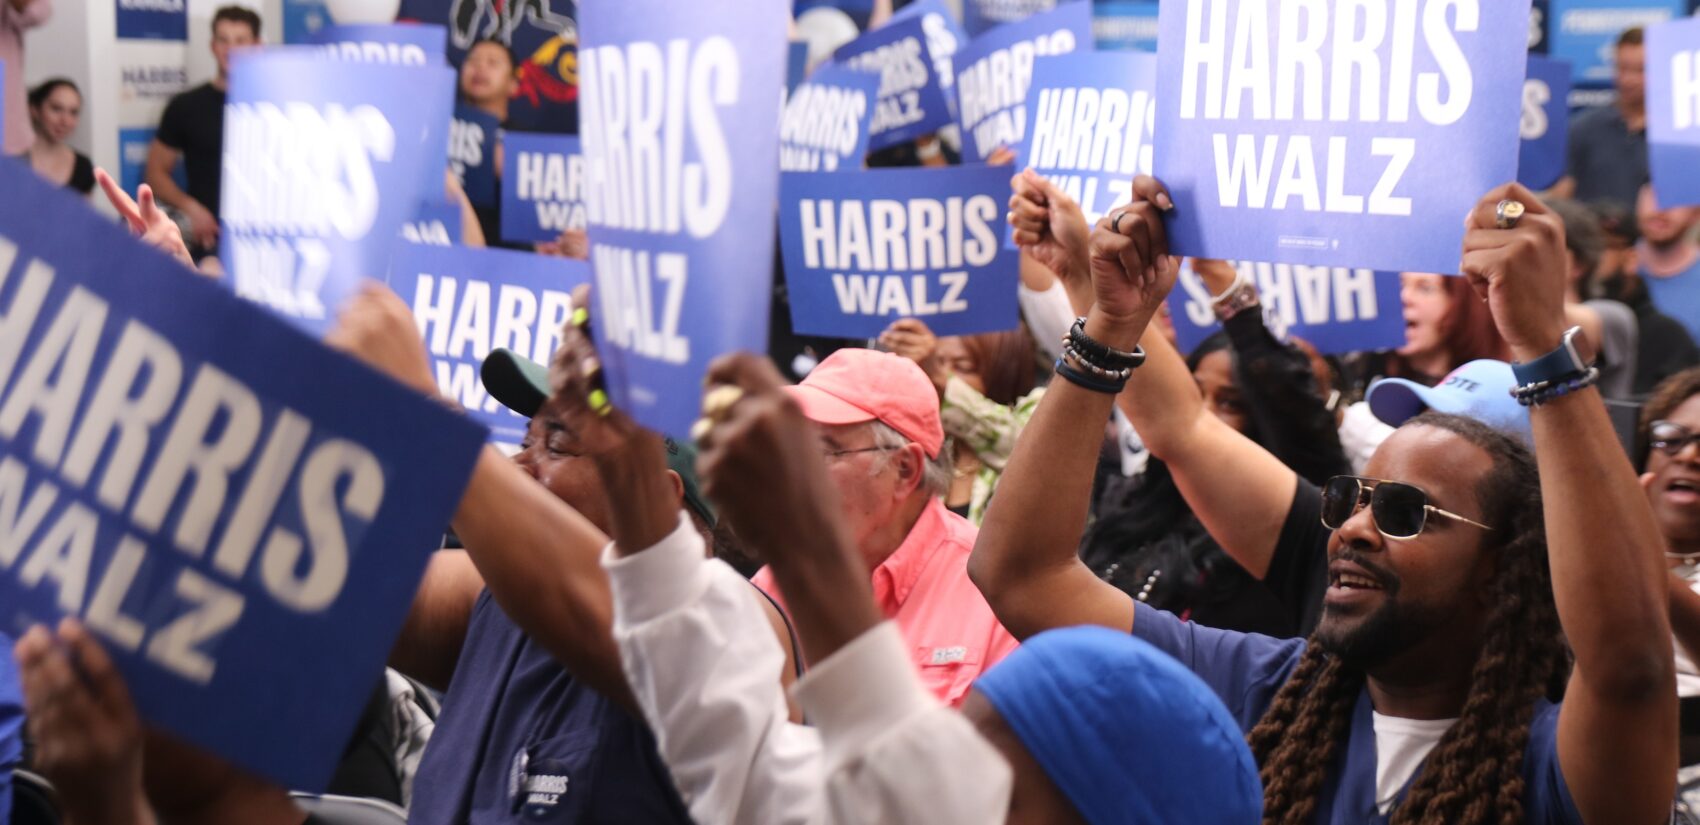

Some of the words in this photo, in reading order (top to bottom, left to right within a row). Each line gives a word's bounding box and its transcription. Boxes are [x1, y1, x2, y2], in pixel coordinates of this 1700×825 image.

[1180, 0, 1479, 126] HARRIS
[1213, 133, 1416, 217] WALZ
[800, 194, 998, 271] HARRIS
[594, 243, 690, 365] WALZ
[831, 271, 969, 316] WALZ
